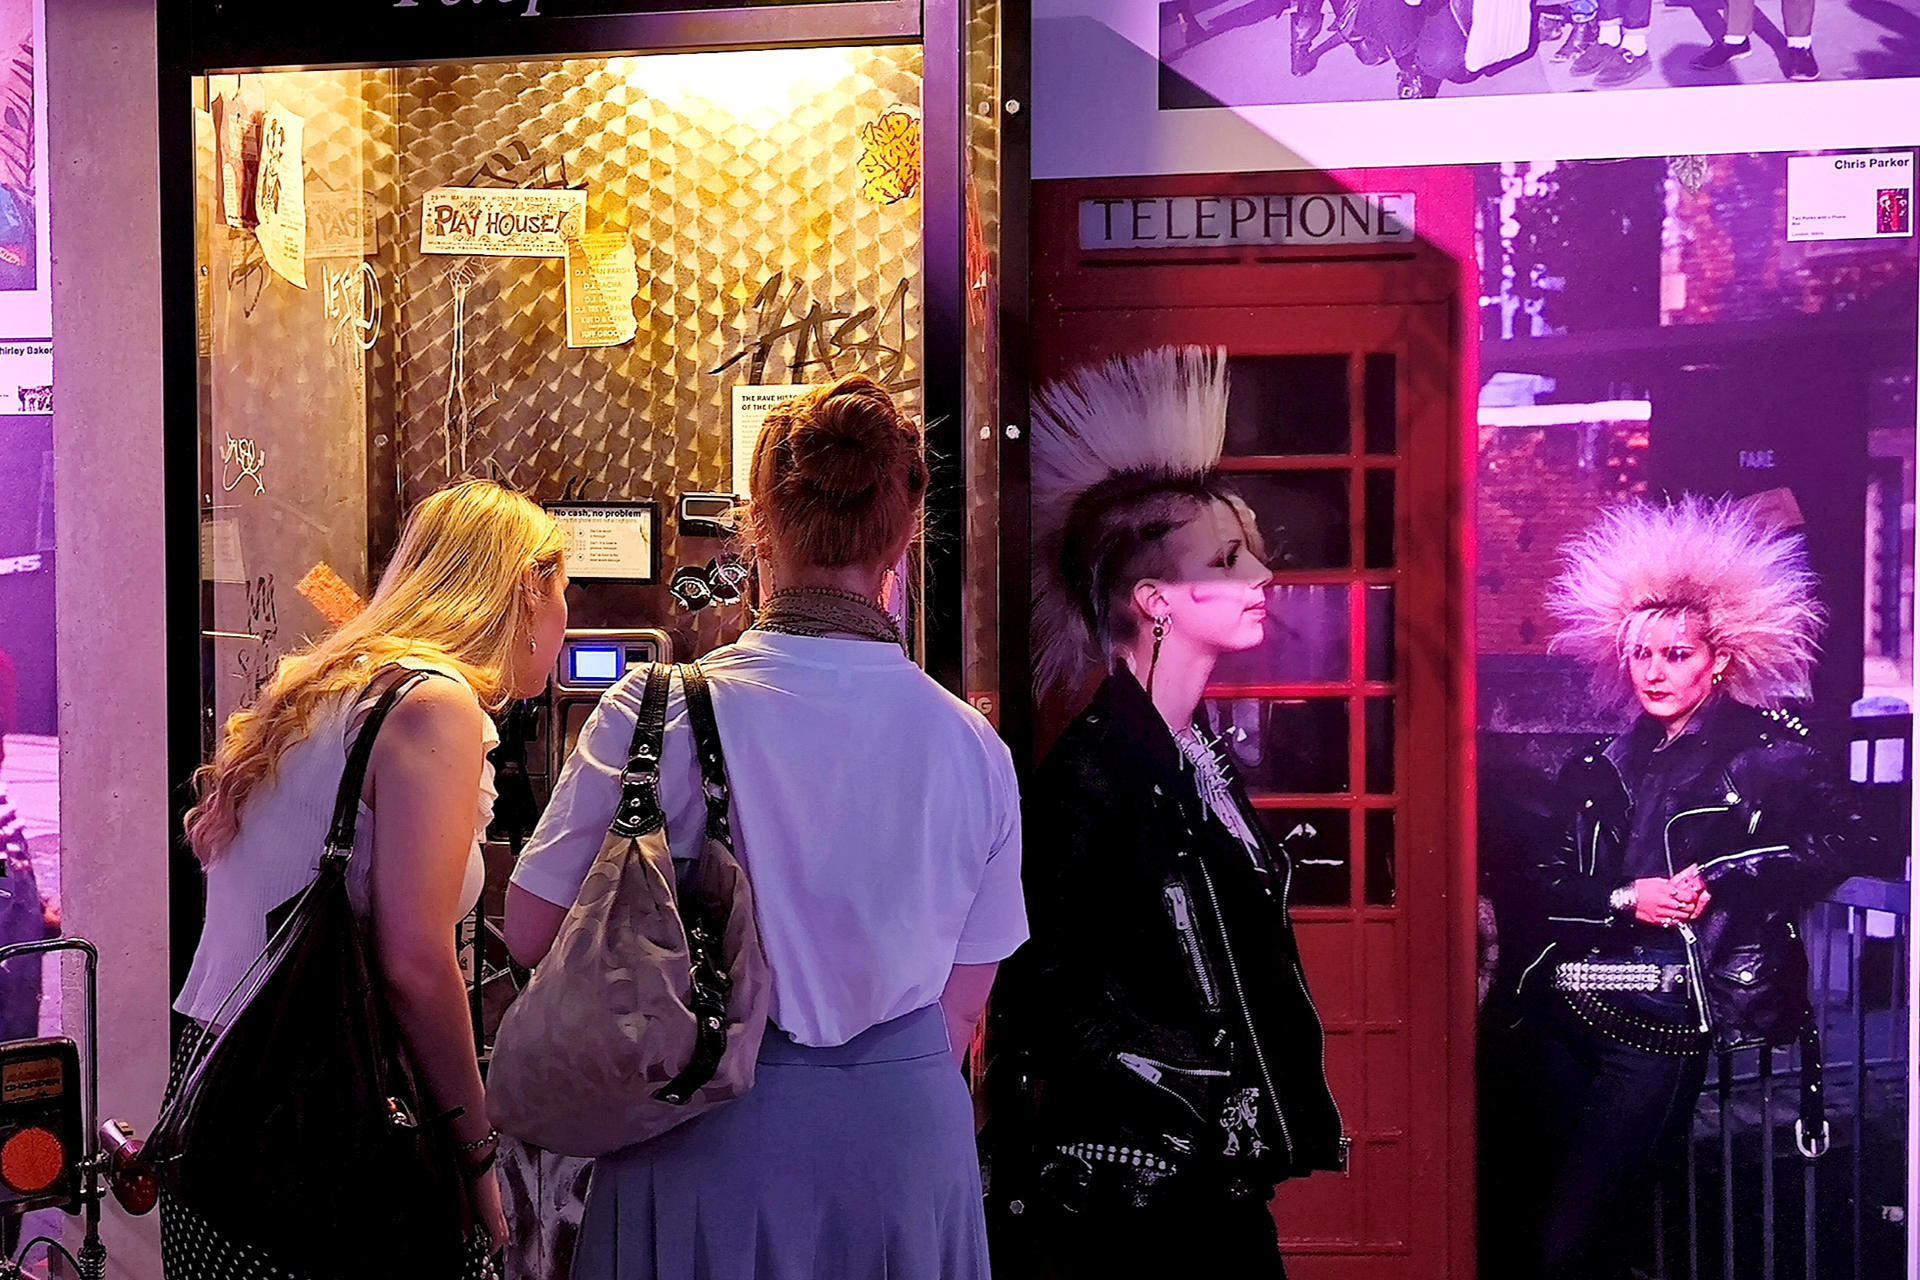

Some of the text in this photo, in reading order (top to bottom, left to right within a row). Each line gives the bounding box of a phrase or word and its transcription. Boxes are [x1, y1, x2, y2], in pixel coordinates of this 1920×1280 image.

[1834, 158, 1910, 169] Chris Parker
[434, 204, 569, 237] PLAY HOUSE!
[1092, 194, 1403, 241] TELEPHONE
[0, 346, 53, 356] hirley Baker
[553, 509, 567, 517] No
[567, 509, 591, 518] cash,
[605, 509, 642, 518] problem
